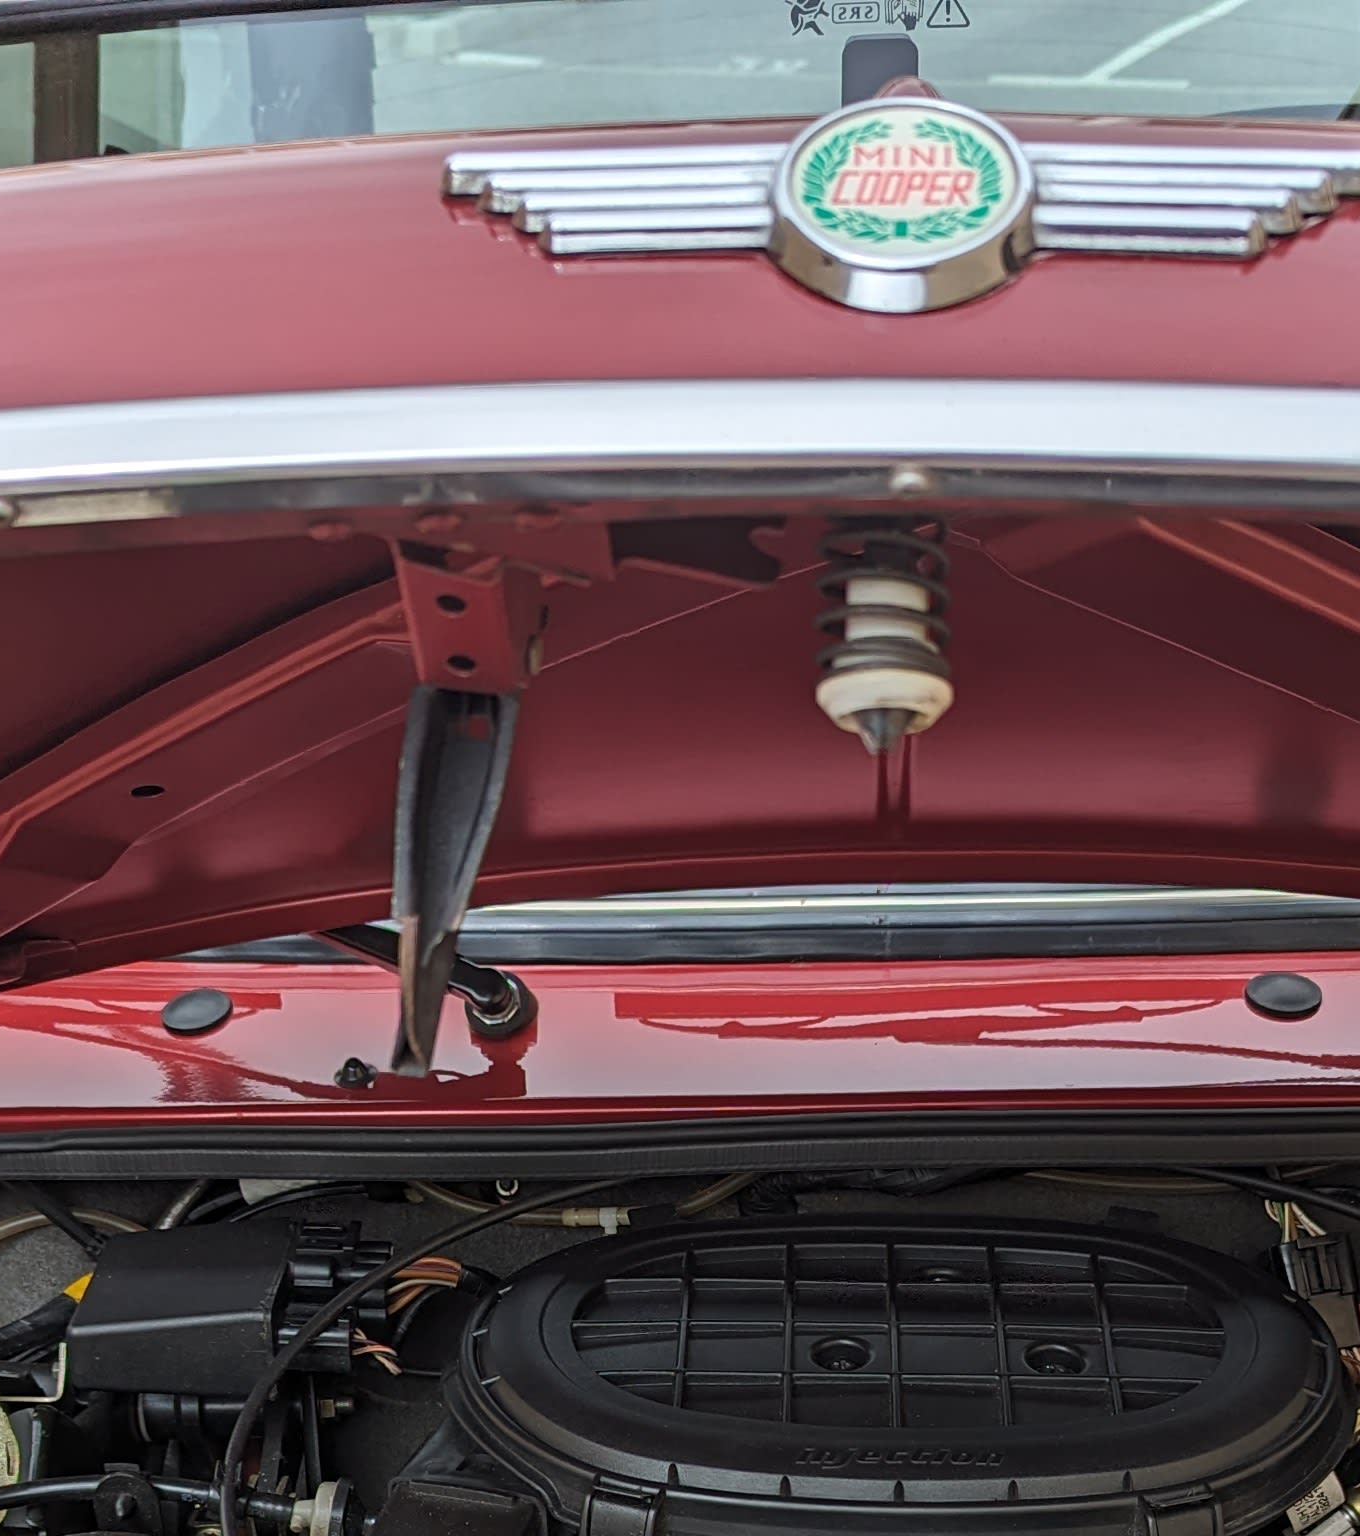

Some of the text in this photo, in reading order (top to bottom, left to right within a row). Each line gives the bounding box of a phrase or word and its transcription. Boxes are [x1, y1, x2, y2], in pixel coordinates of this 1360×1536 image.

[852, 146, 952, 167] MINI
[830, 170, 977, 206] COOPER
[794, 1447, 1007, 1470] injection
